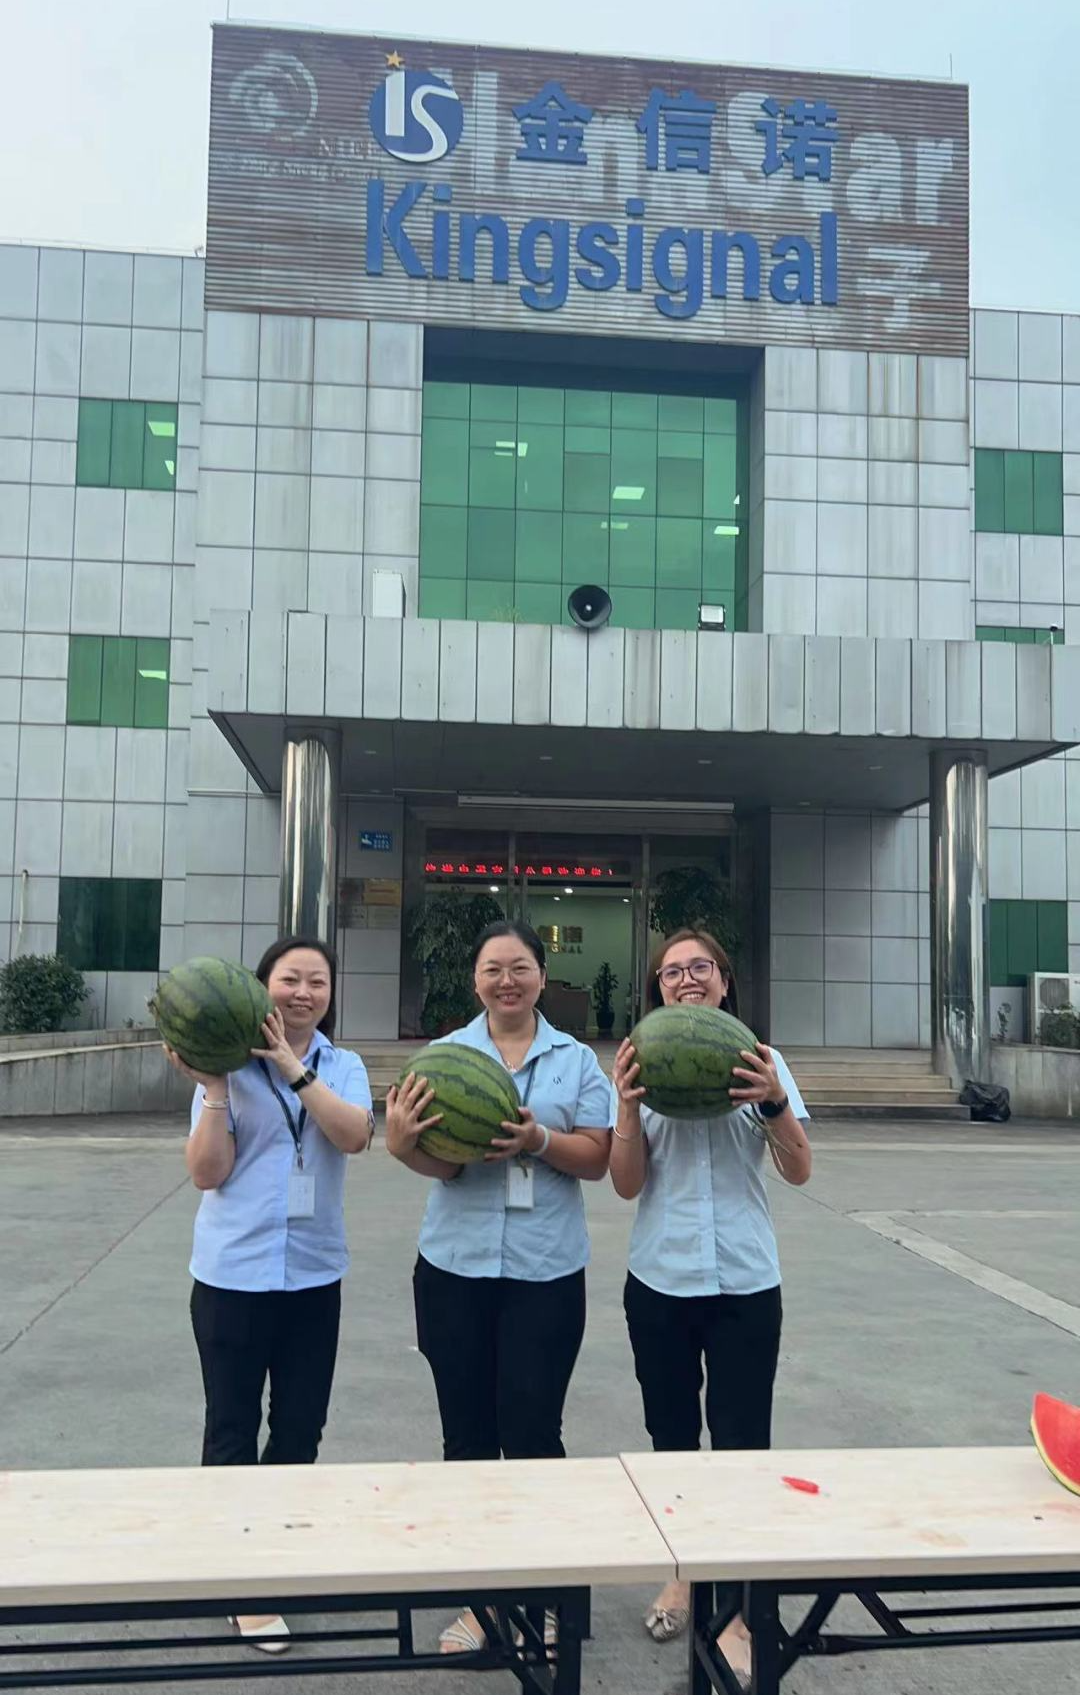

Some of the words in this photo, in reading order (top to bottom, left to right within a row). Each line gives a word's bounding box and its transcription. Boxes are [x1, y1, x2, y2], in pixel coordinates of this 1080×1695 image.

[512, 80, 840, 182] 金信诺
[365, 177, 839, 319] Kingsignal
